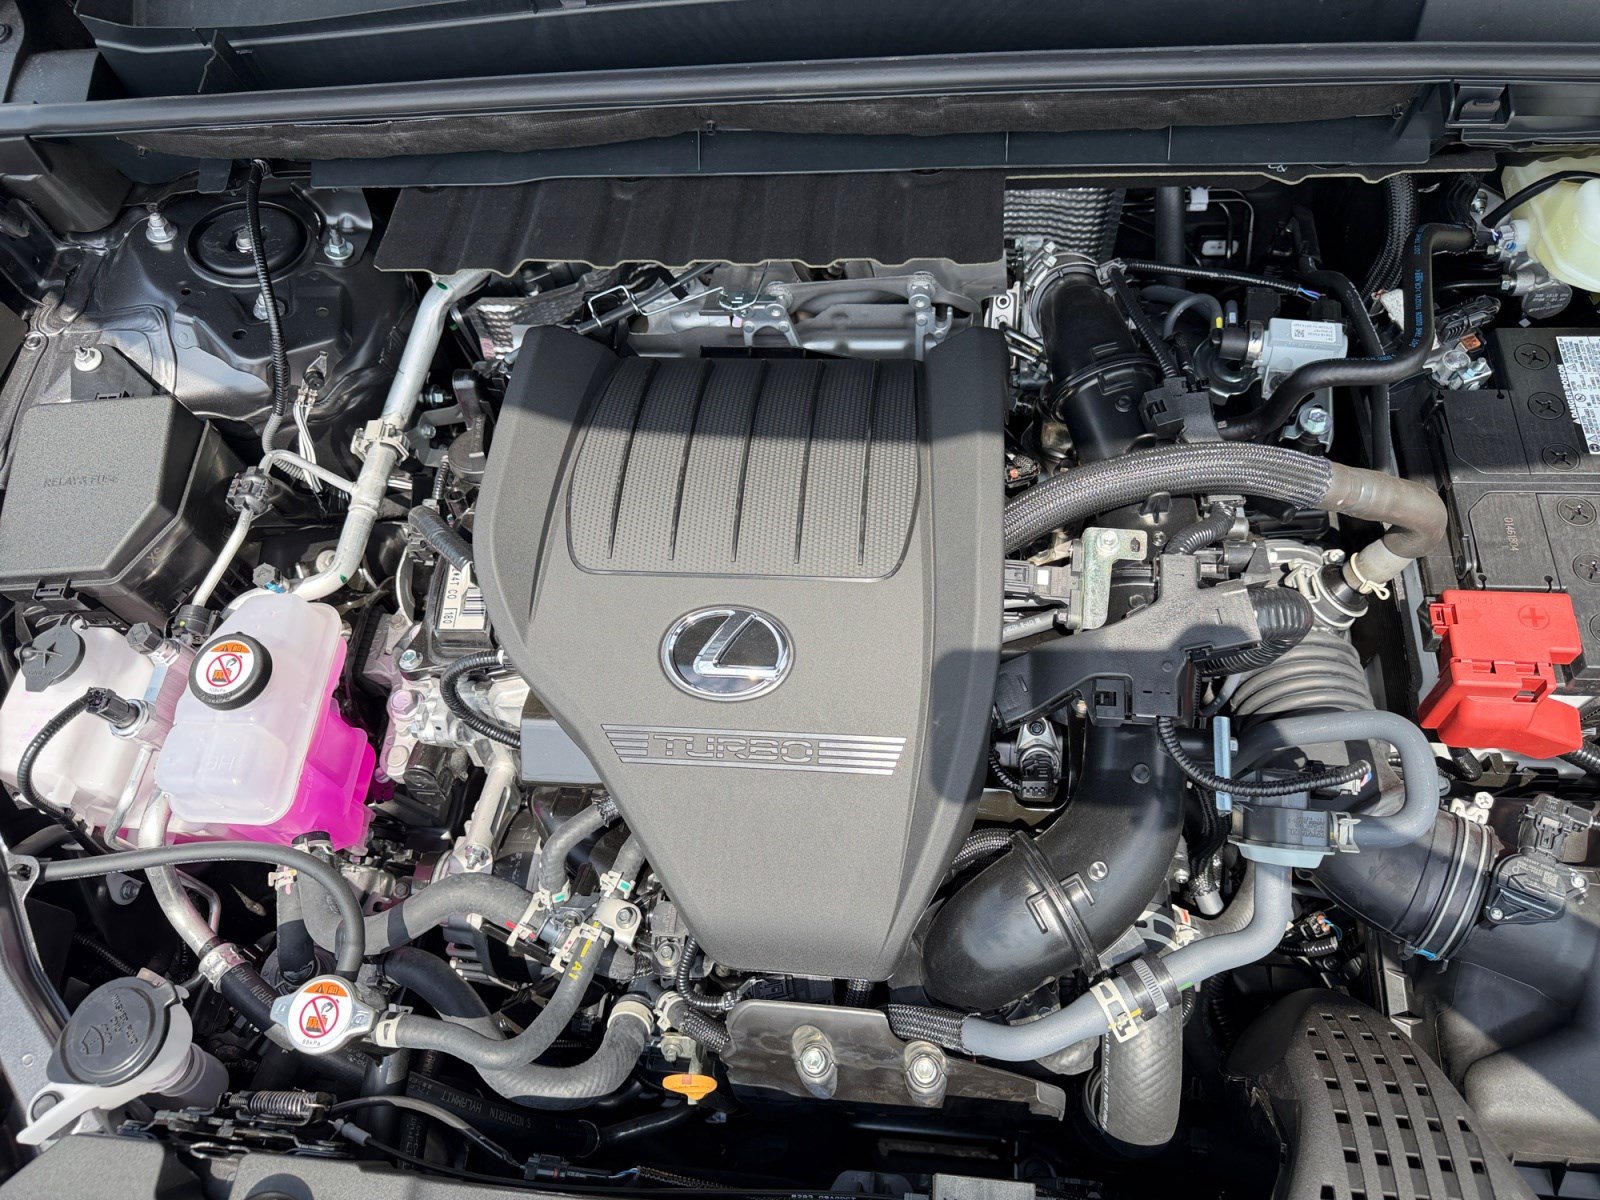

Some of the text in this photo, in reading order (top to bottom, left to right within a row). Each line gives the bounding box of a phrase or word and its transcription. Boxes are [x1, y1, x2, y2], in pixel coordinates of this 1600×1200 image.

[1557, 364, 1578, 417] DANGER POISON
[443, 612, 454, 624] 180
[653, 735, 813, 763] TURBO
[568, 960, 582, 981] A1
